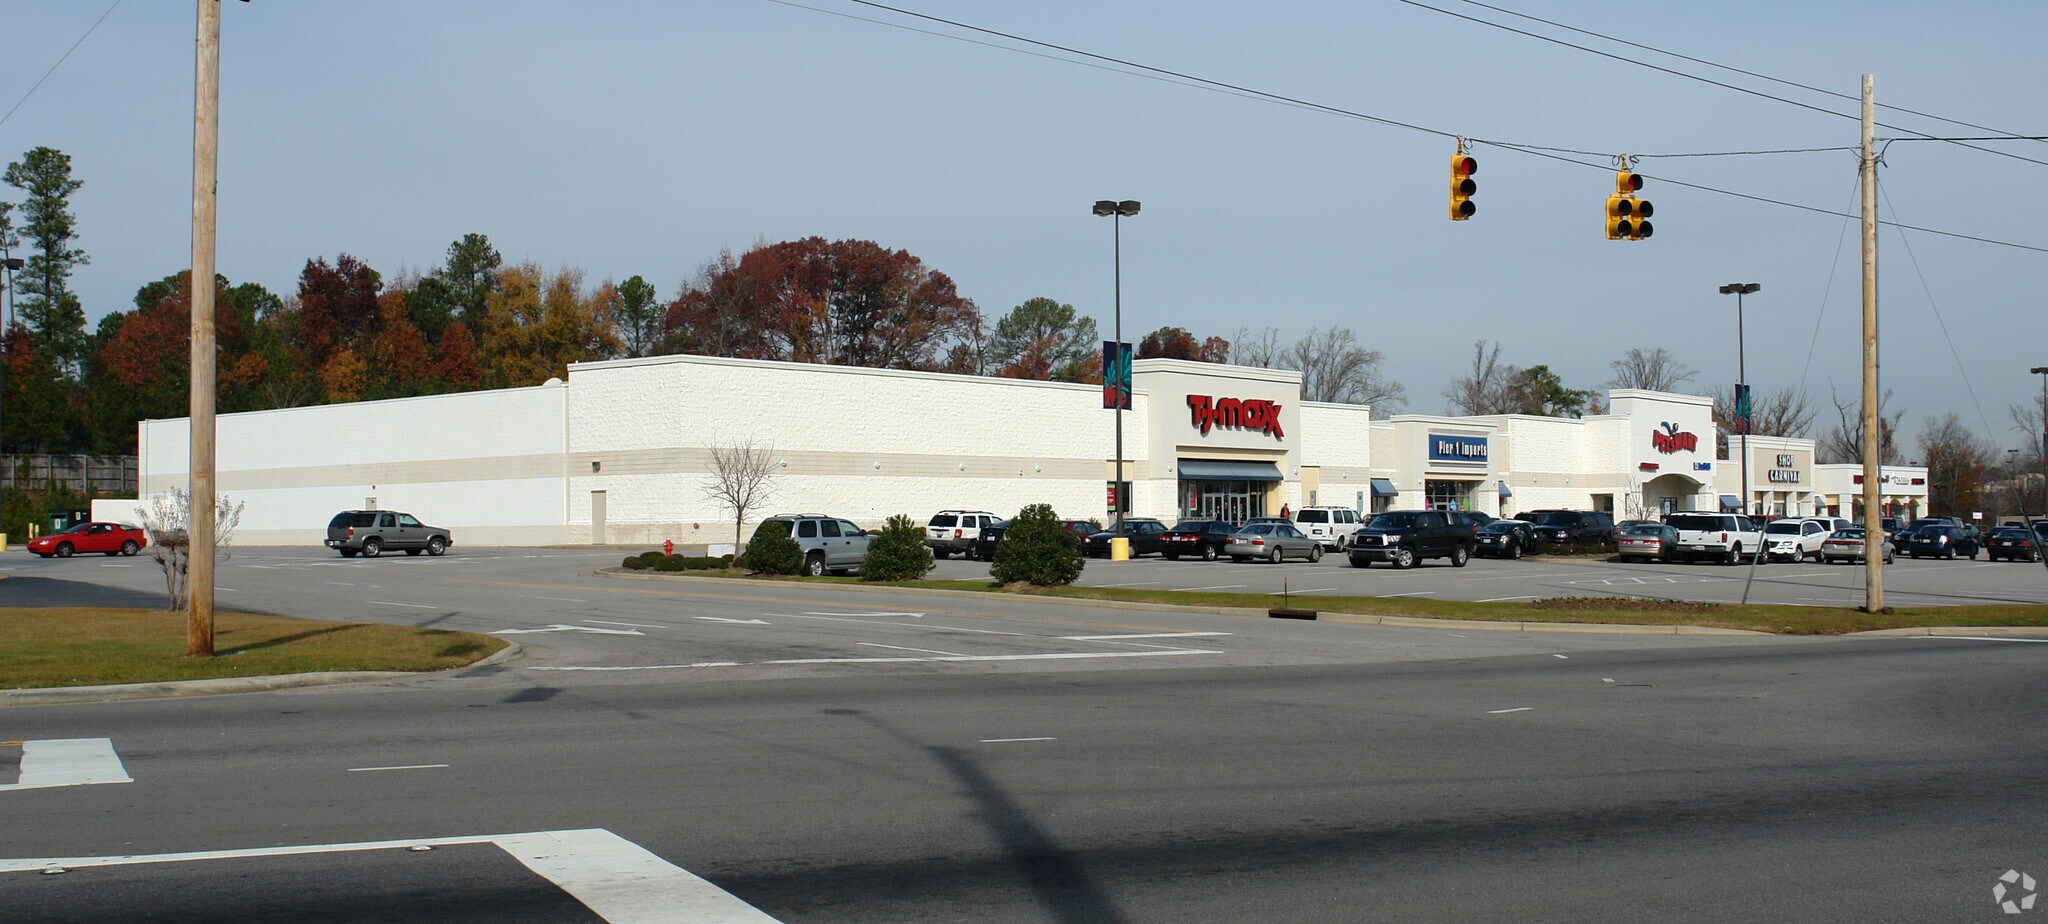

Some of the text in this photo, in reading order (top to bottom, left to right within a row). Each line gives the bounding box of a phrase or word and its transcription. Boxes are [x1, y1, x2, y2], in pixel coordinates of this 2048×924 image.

[1438, 440, 1453, 455] Pier
[1777, 454, 1794, 467] SHOE
[1769, 469, 1800, 483] CARNIVAL
